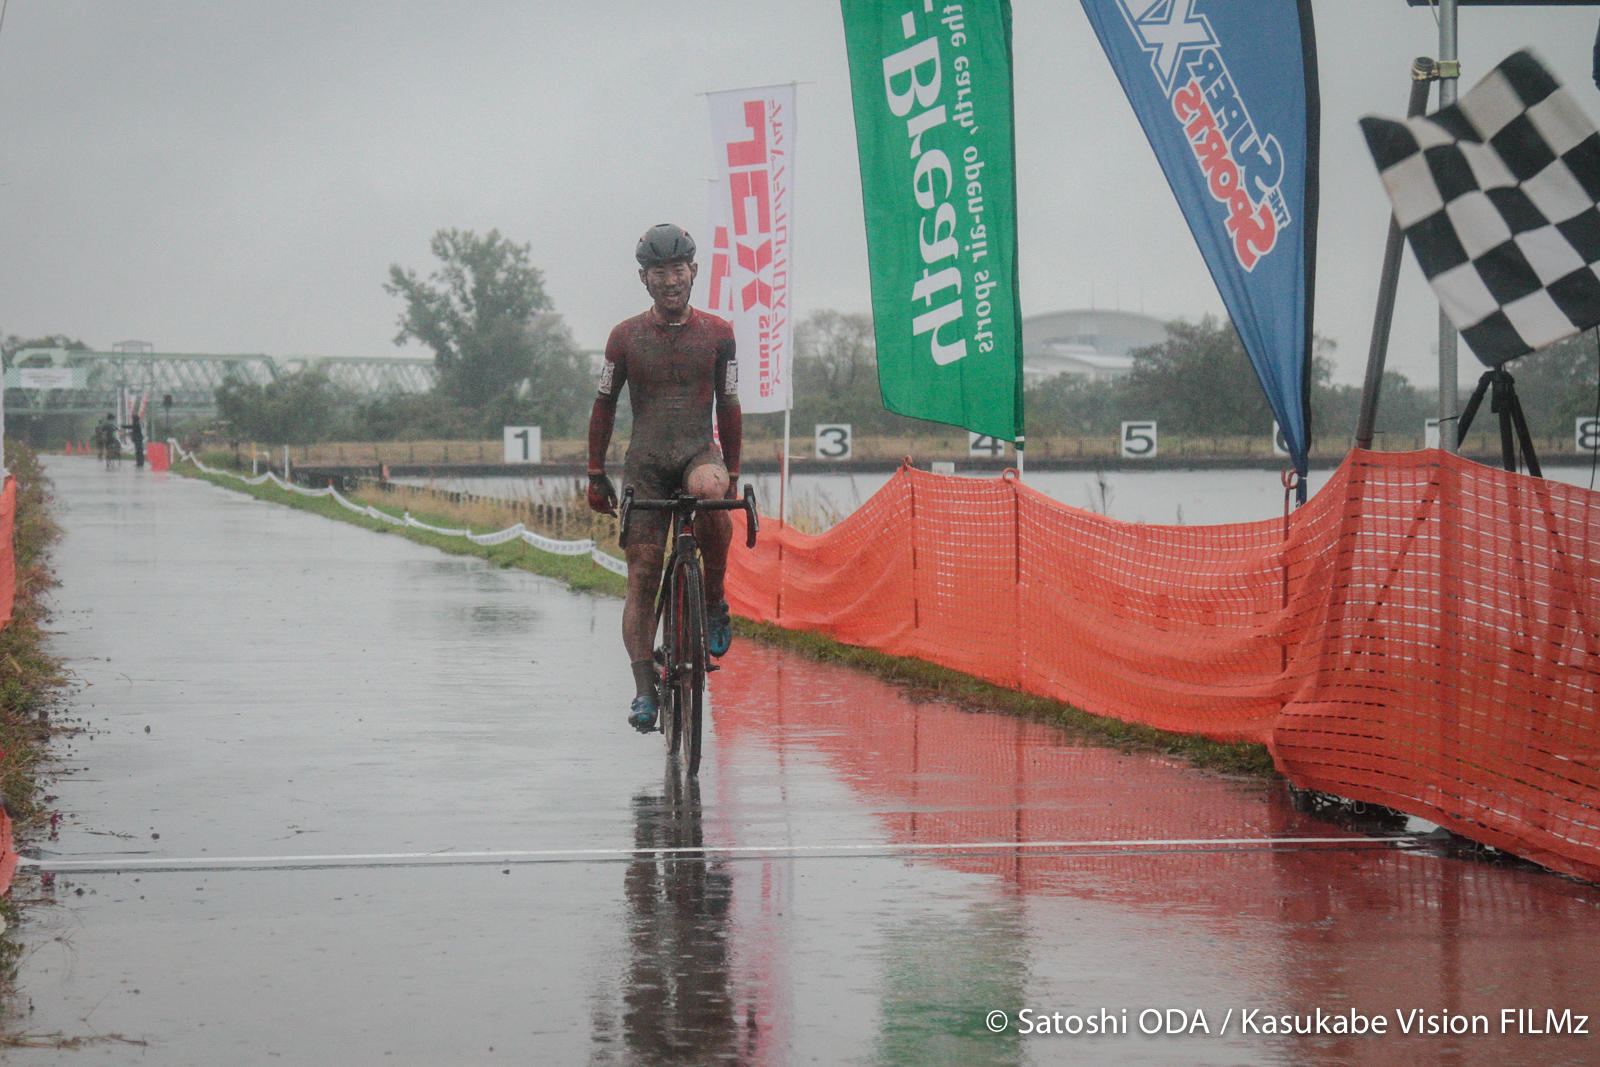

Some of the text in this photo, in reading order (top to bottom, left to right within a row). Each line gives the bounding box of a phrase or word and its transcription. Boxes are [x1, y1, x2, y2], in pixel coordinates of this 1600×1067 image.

[513, 429, 529, 461] 1
[819, 427, 849, 458] 3
[1125, 424, 1154, 455] 5
